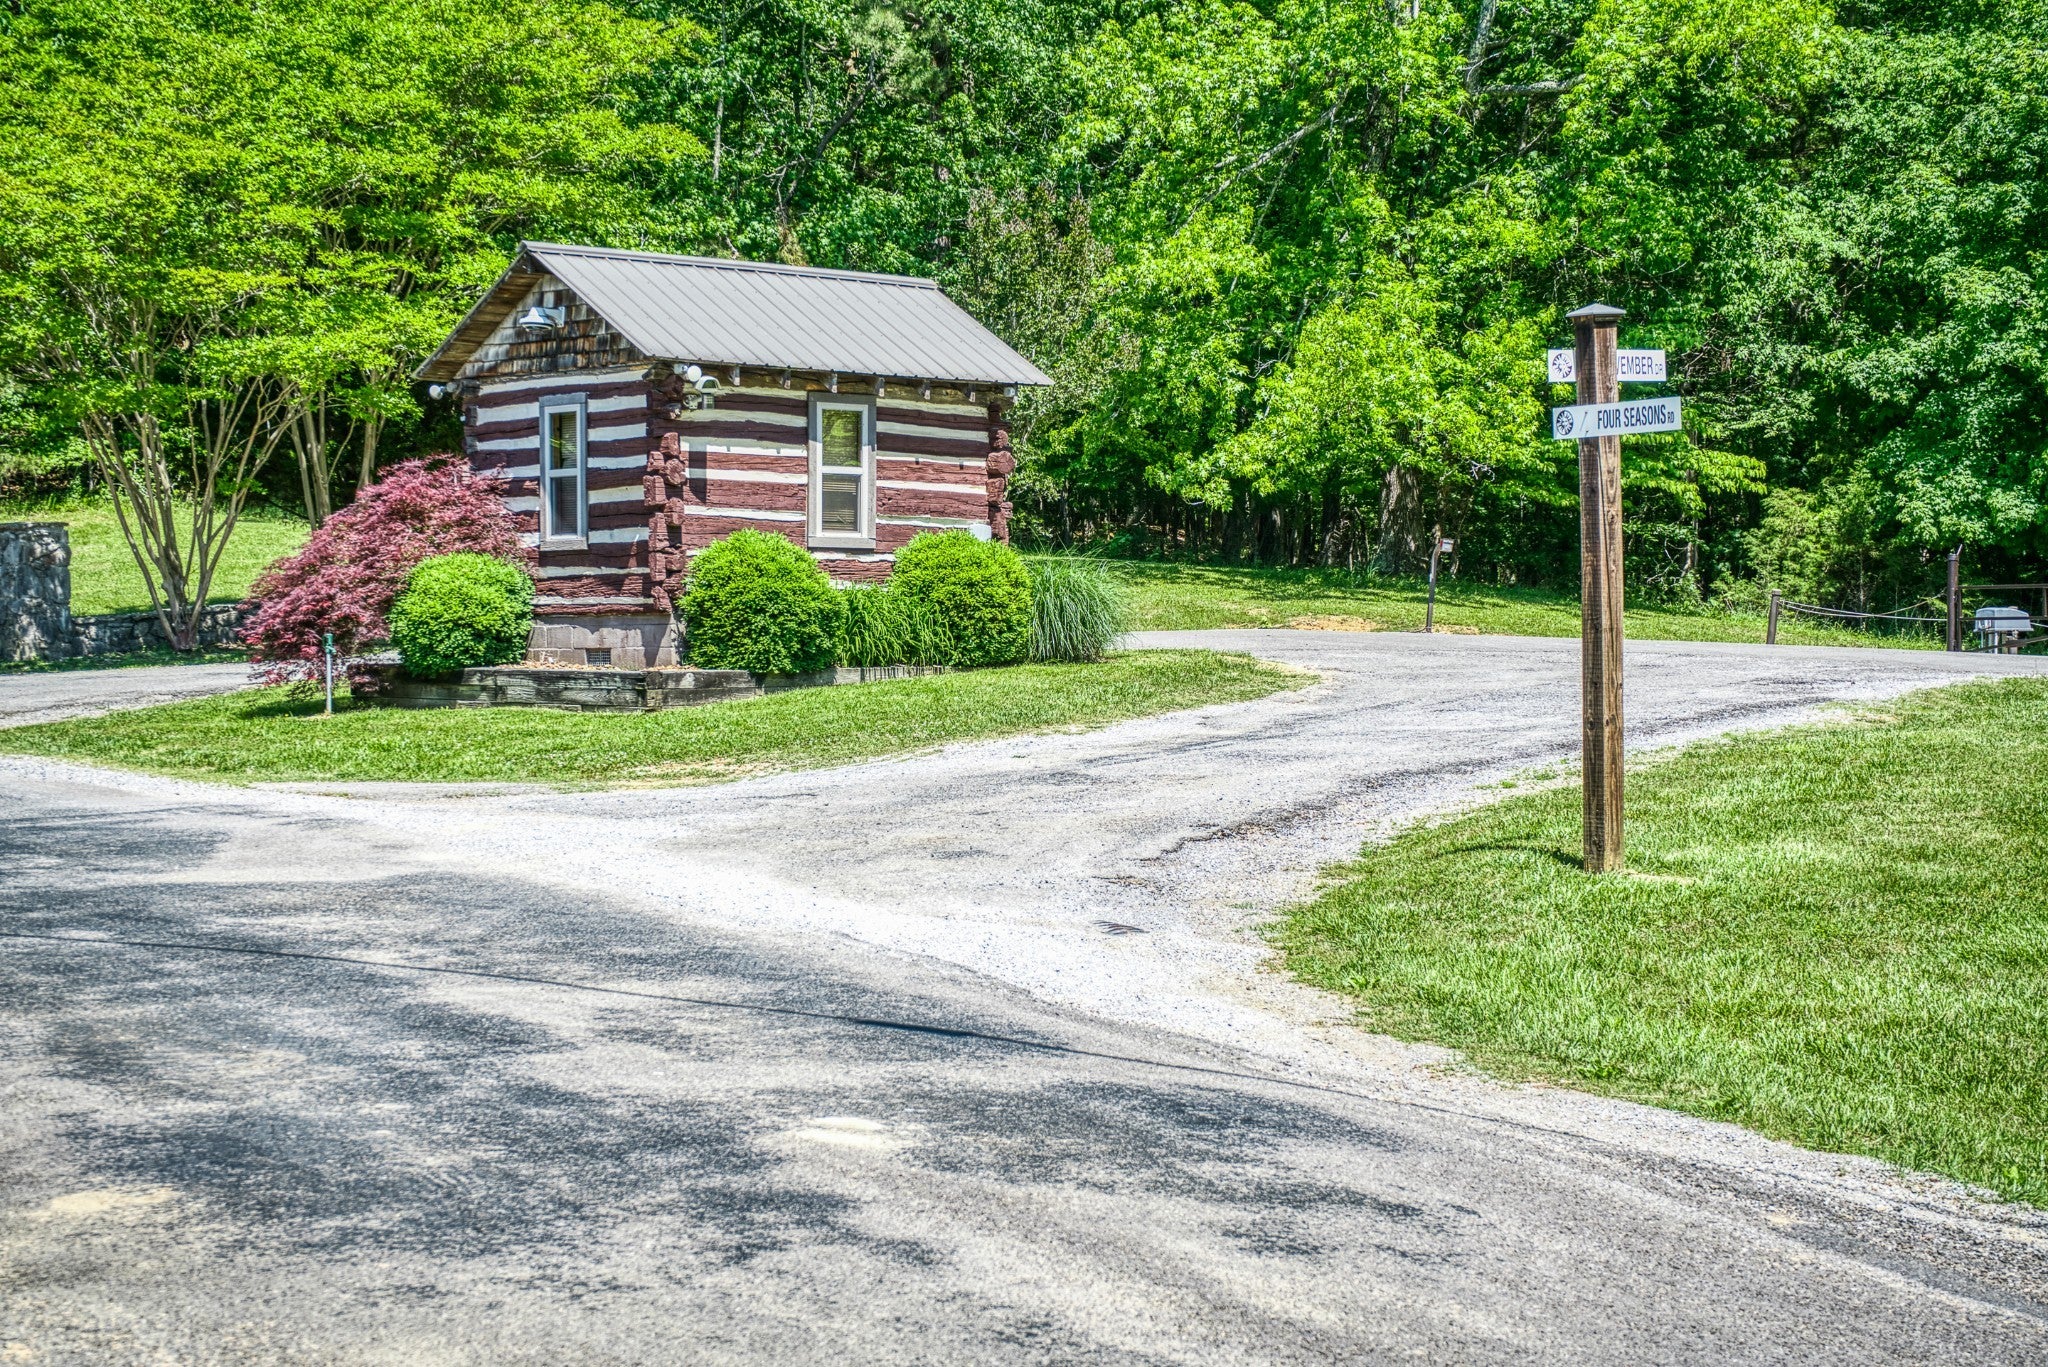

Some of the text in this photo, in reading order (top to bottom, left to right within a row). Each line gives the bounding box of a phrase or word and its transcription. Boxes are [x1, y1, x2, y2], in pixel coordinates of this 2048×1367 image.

[1597, 404, 1675, 429] FOUR SEASONS RD
